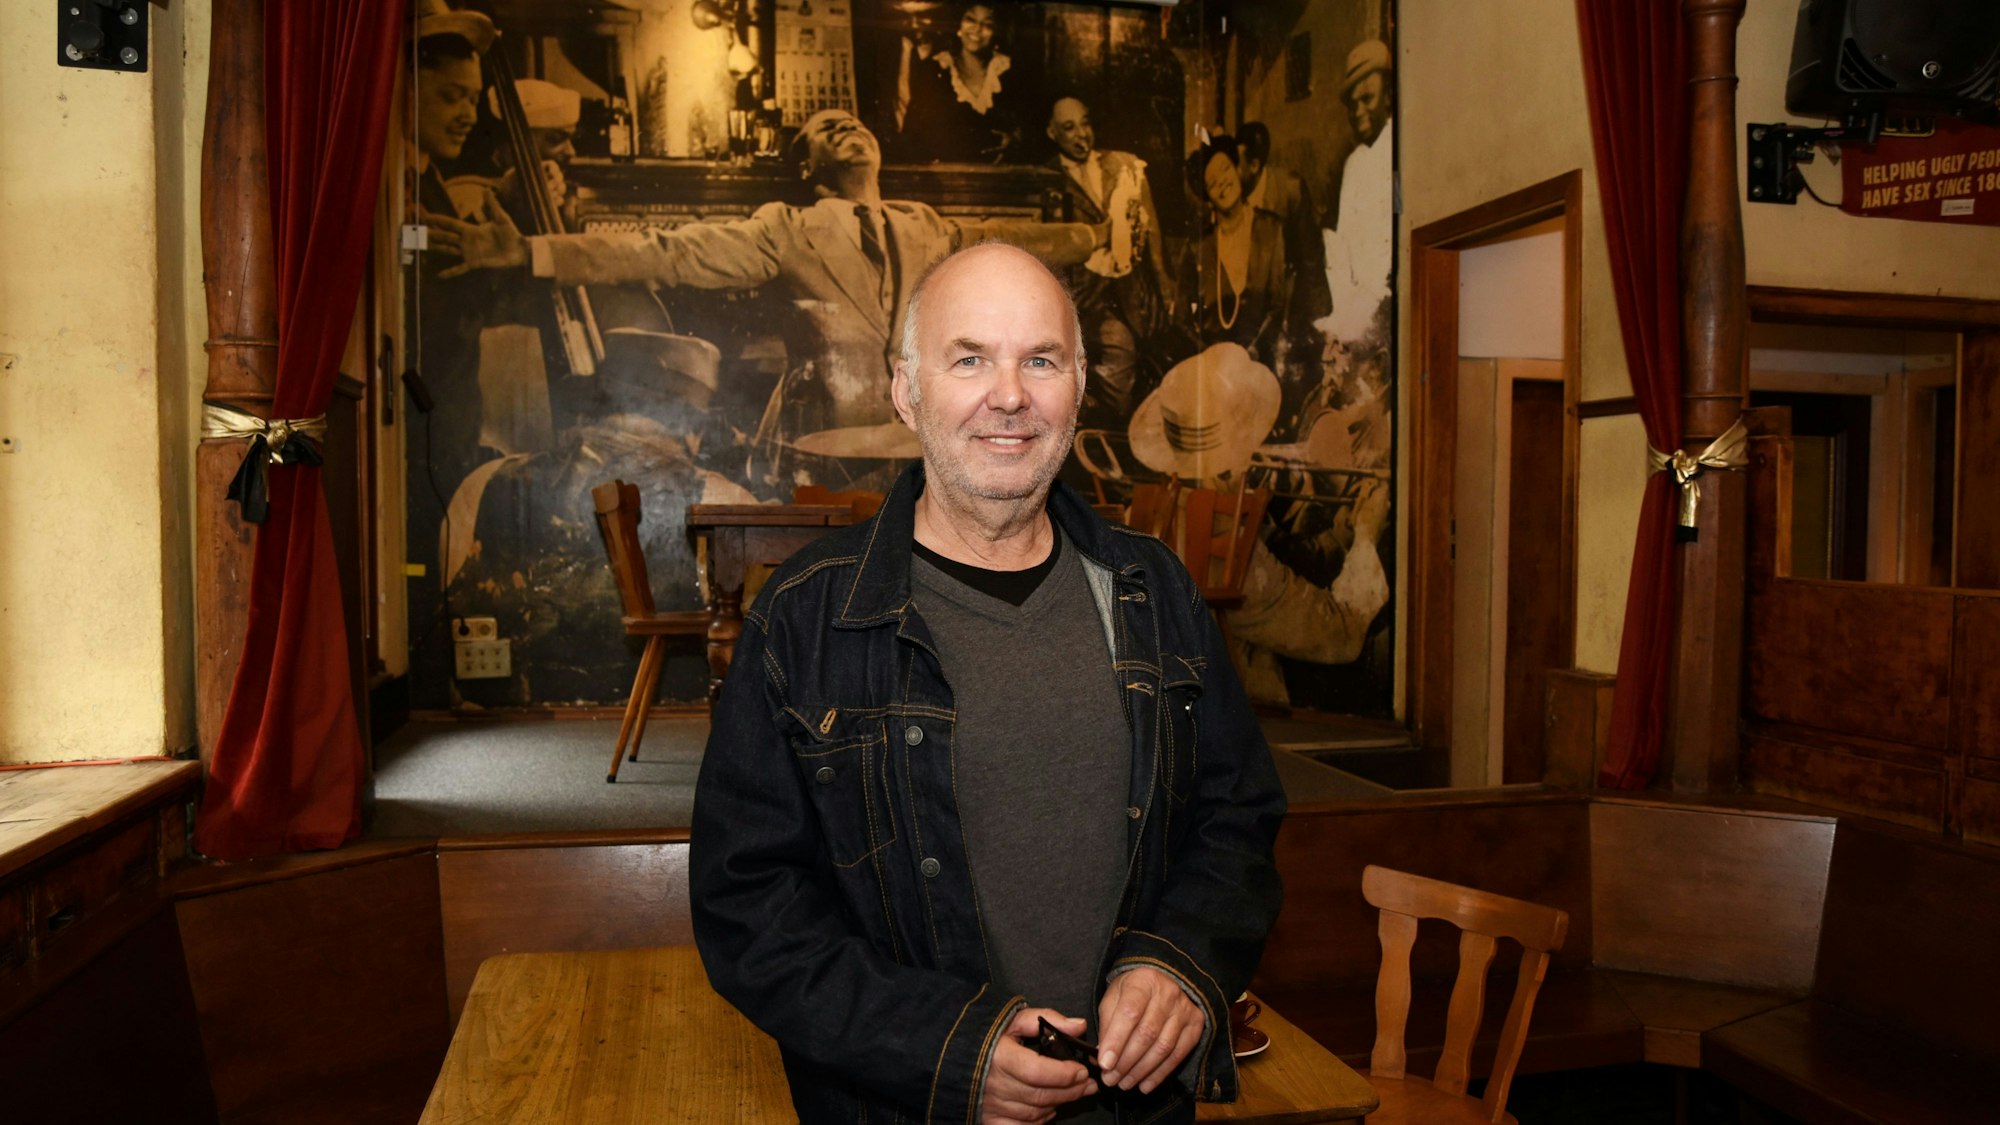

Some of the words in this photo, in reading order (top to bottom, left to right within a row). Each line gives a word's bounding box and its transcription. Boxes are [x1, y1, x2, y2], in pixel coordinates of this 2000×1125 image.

[1863, 159, 1926, 185] HELPING
[1931, 154, 1966, 177] UGLY
[1861, 186, 1900, 209] HAVE
[1903, 181, 1931, 204] SEX
[1934, 176, 1972, 199] SINCE
